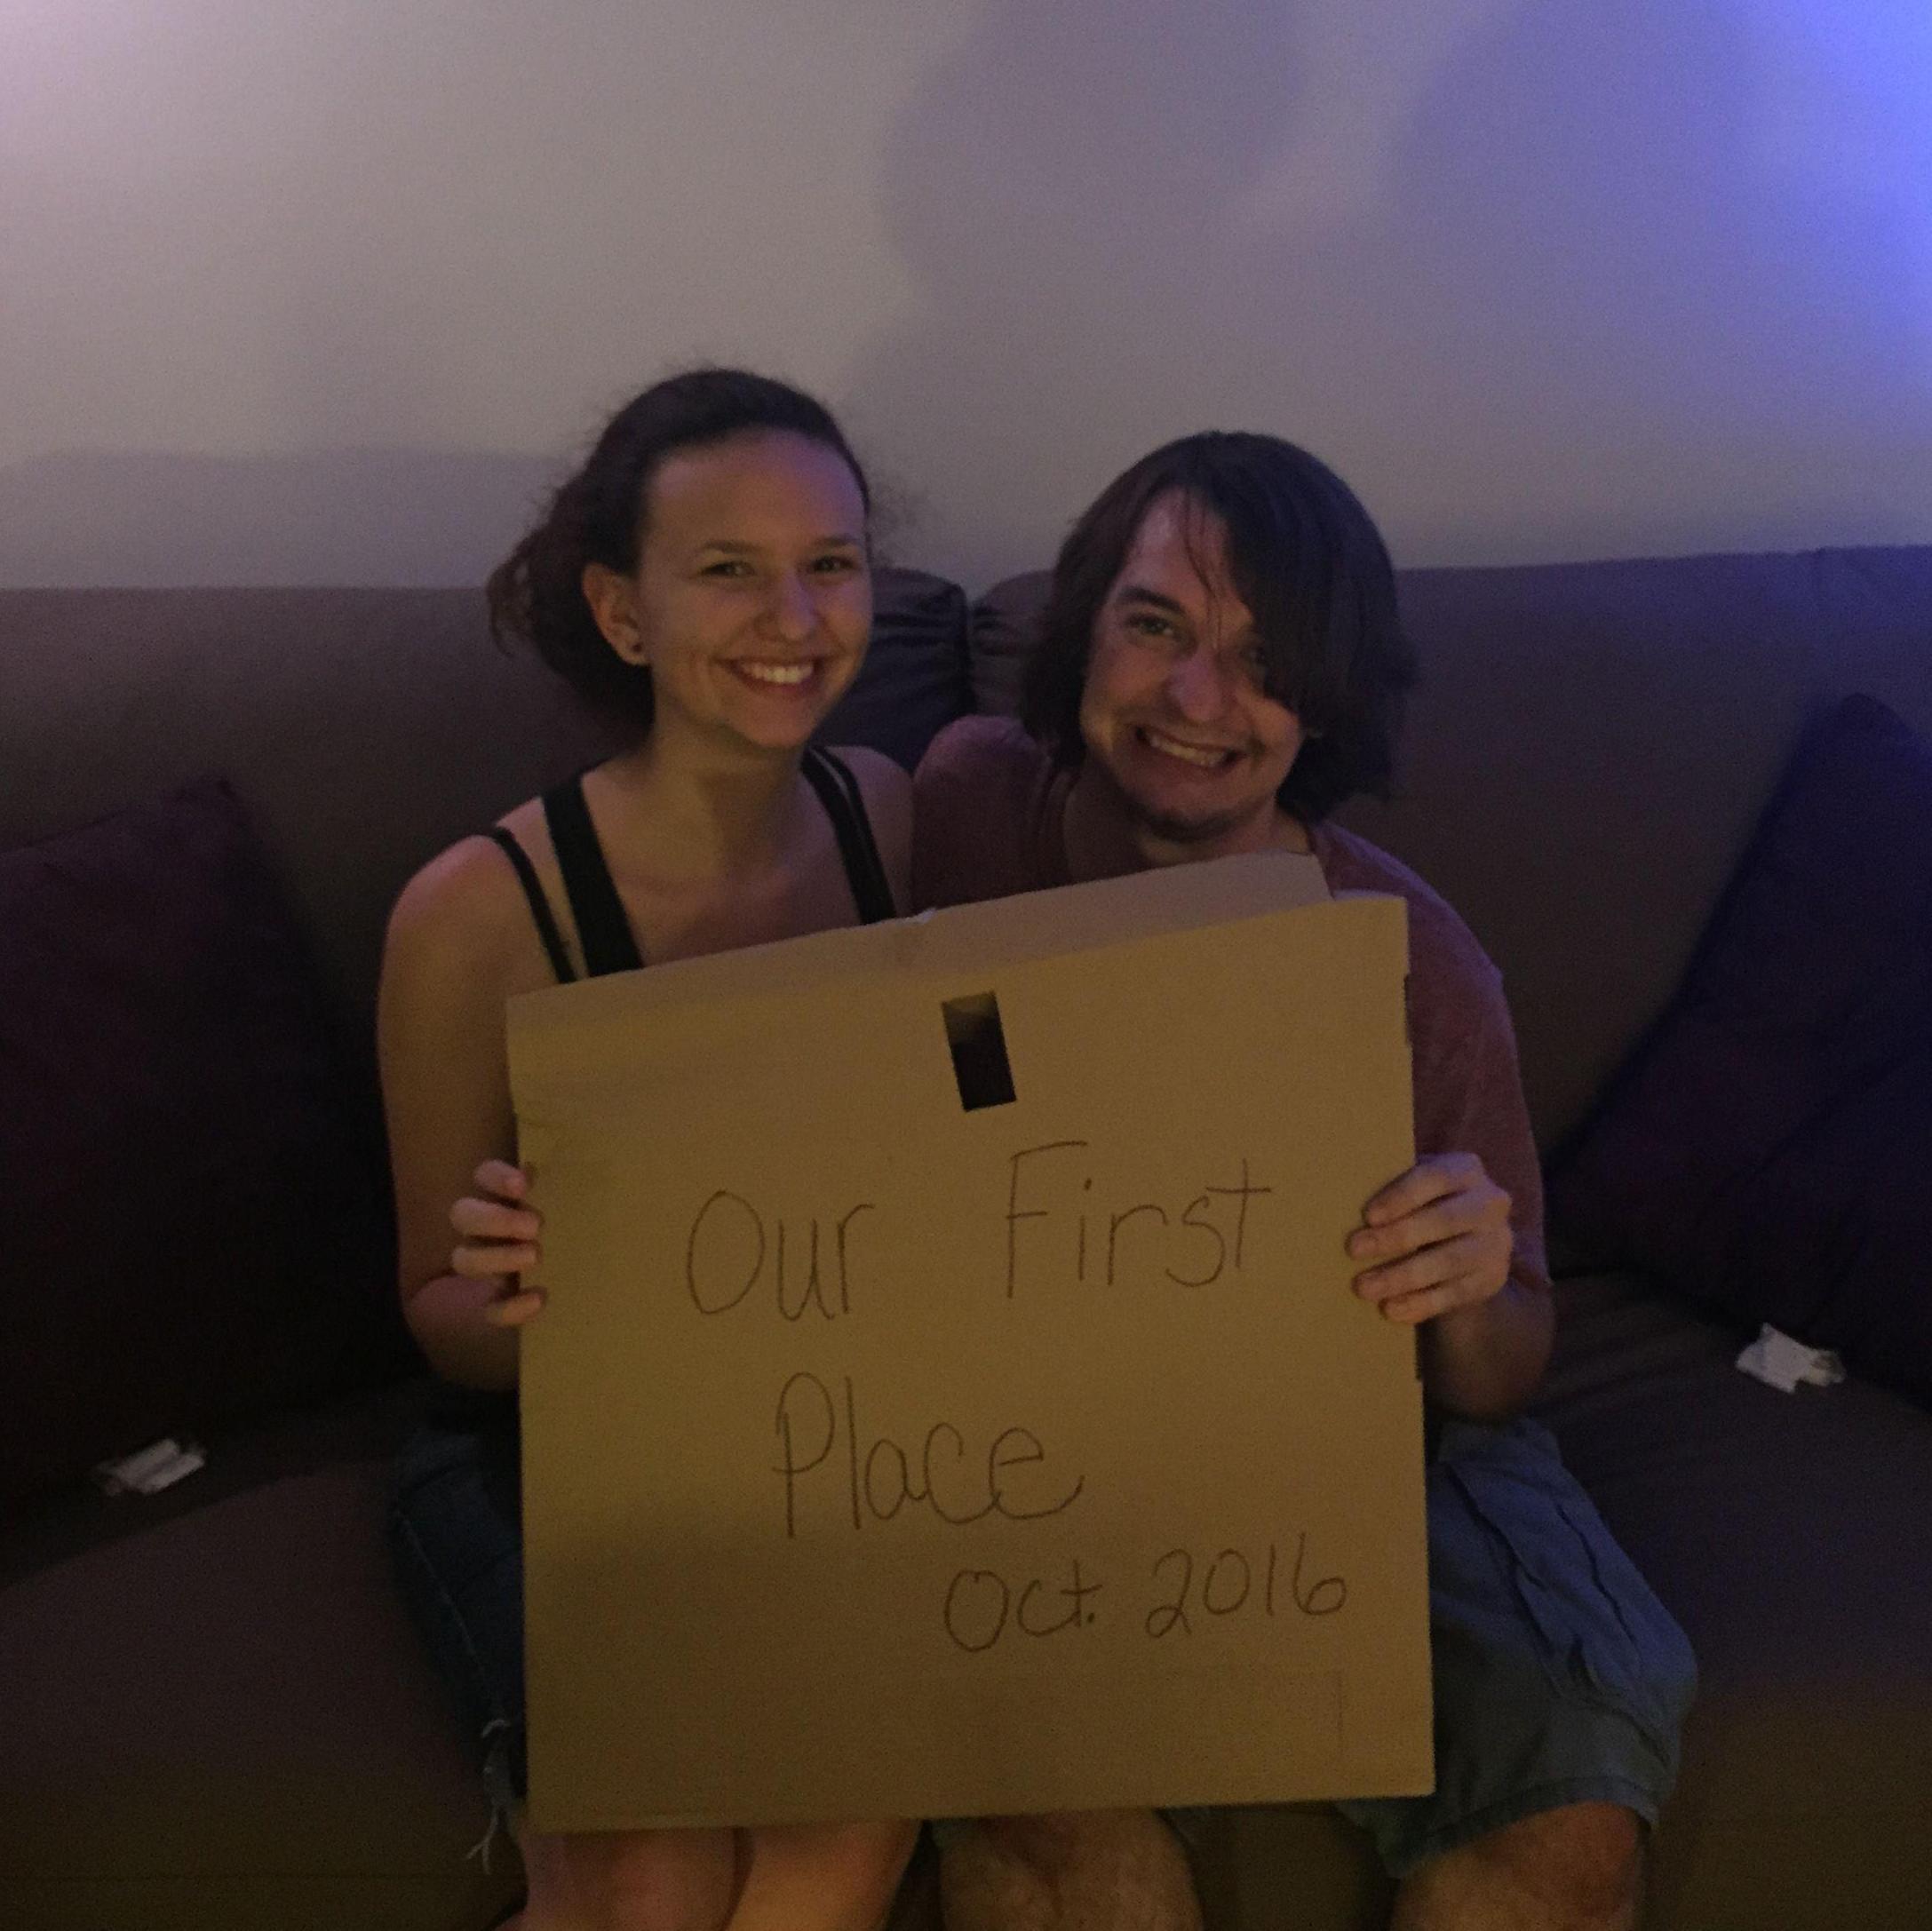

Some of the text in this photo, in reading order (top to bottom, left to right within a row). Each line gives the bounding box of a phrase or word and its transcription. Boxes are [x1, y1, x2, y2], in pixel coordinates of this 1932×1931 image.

[686, 1140, 1273, 1322] Our First
[772, 1371, 1085, 1539] Place
[943, 1531, 1347, 1653] Oct. 2016
